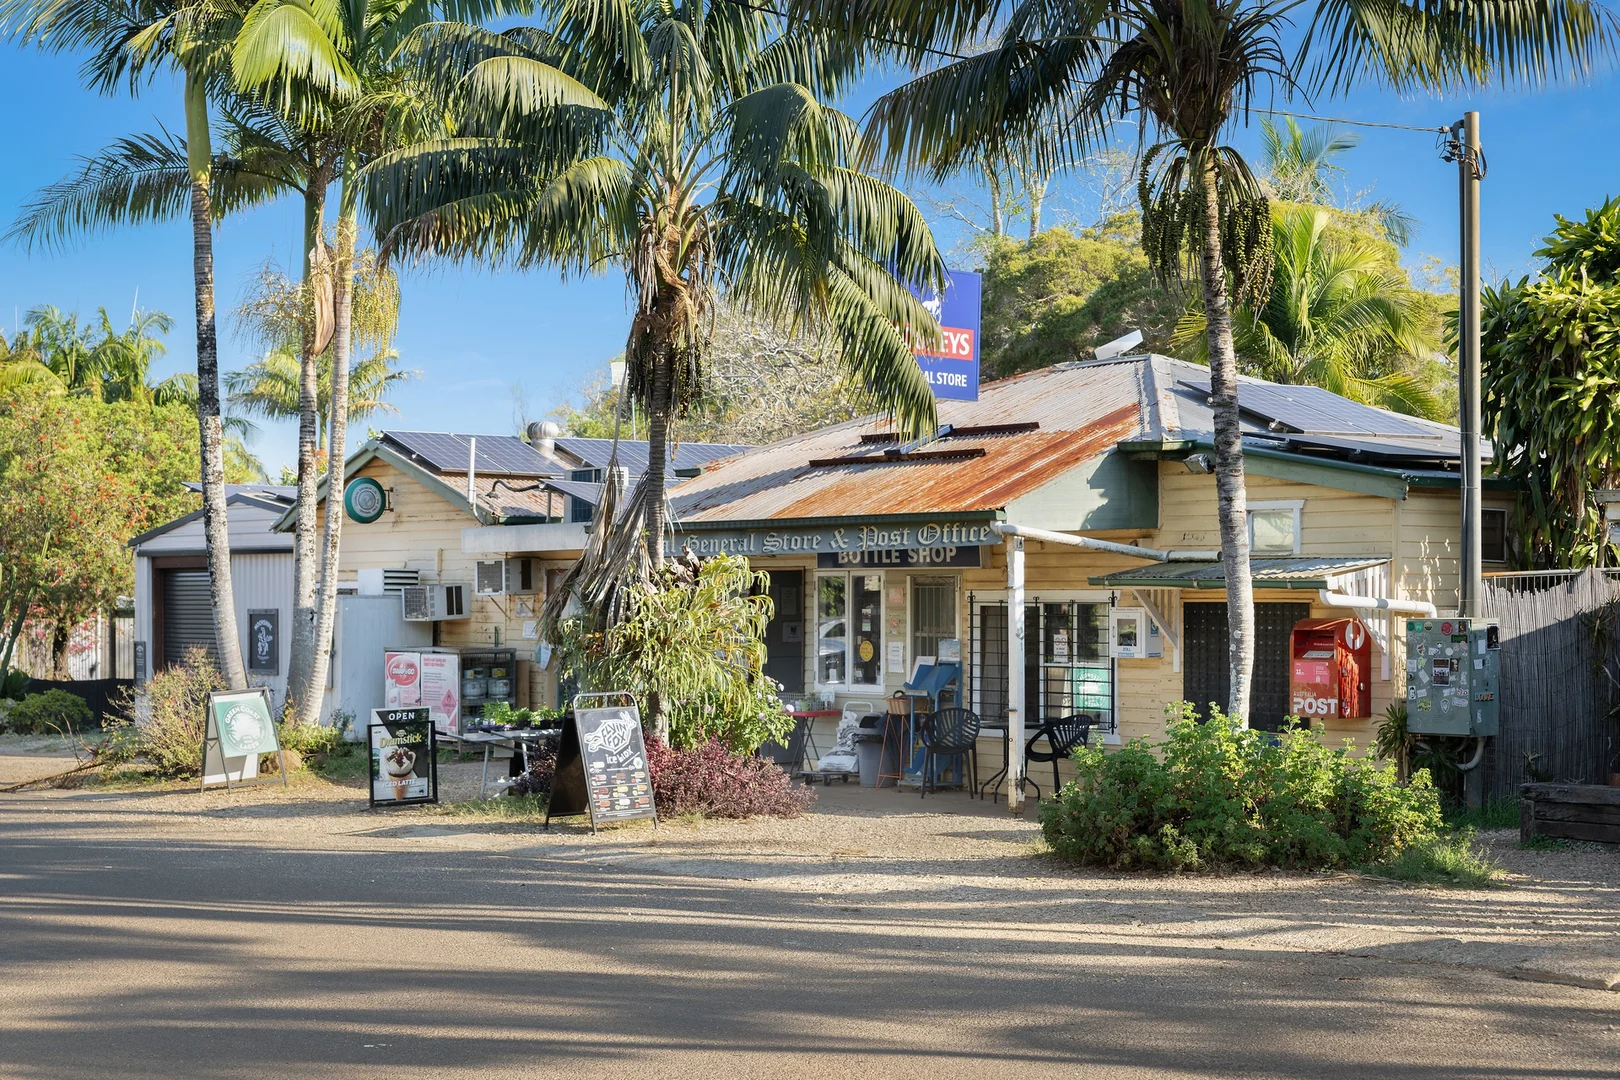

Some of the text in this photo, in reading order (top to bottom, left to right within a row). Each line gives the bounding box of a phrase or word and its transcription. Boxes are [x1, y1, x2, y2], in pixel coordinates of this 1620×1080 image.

[937, 372, 967, 387] STORE
[684, 533, 755, 552] General
[762, 531, 821, 552] Store
[829, 527, 849, 549] &
[857, 525, 911, 550] Post
[917, 521, 991, 545] Office
[838, 546, 957, 564] BOTTLE SHOP
[1293, 697, 1338, 714] POST
[225, 705, 261, 723] GREEN COAST
[388, 712, 415, 721] OPEN
[240, 741, 260, 750] LAGER
[607, 731, 626, 747] FOX
[605, 754, 617, 764] ice
[382, 780, 397, 789] ICED
[398, 778, 416, 787] LATTE
